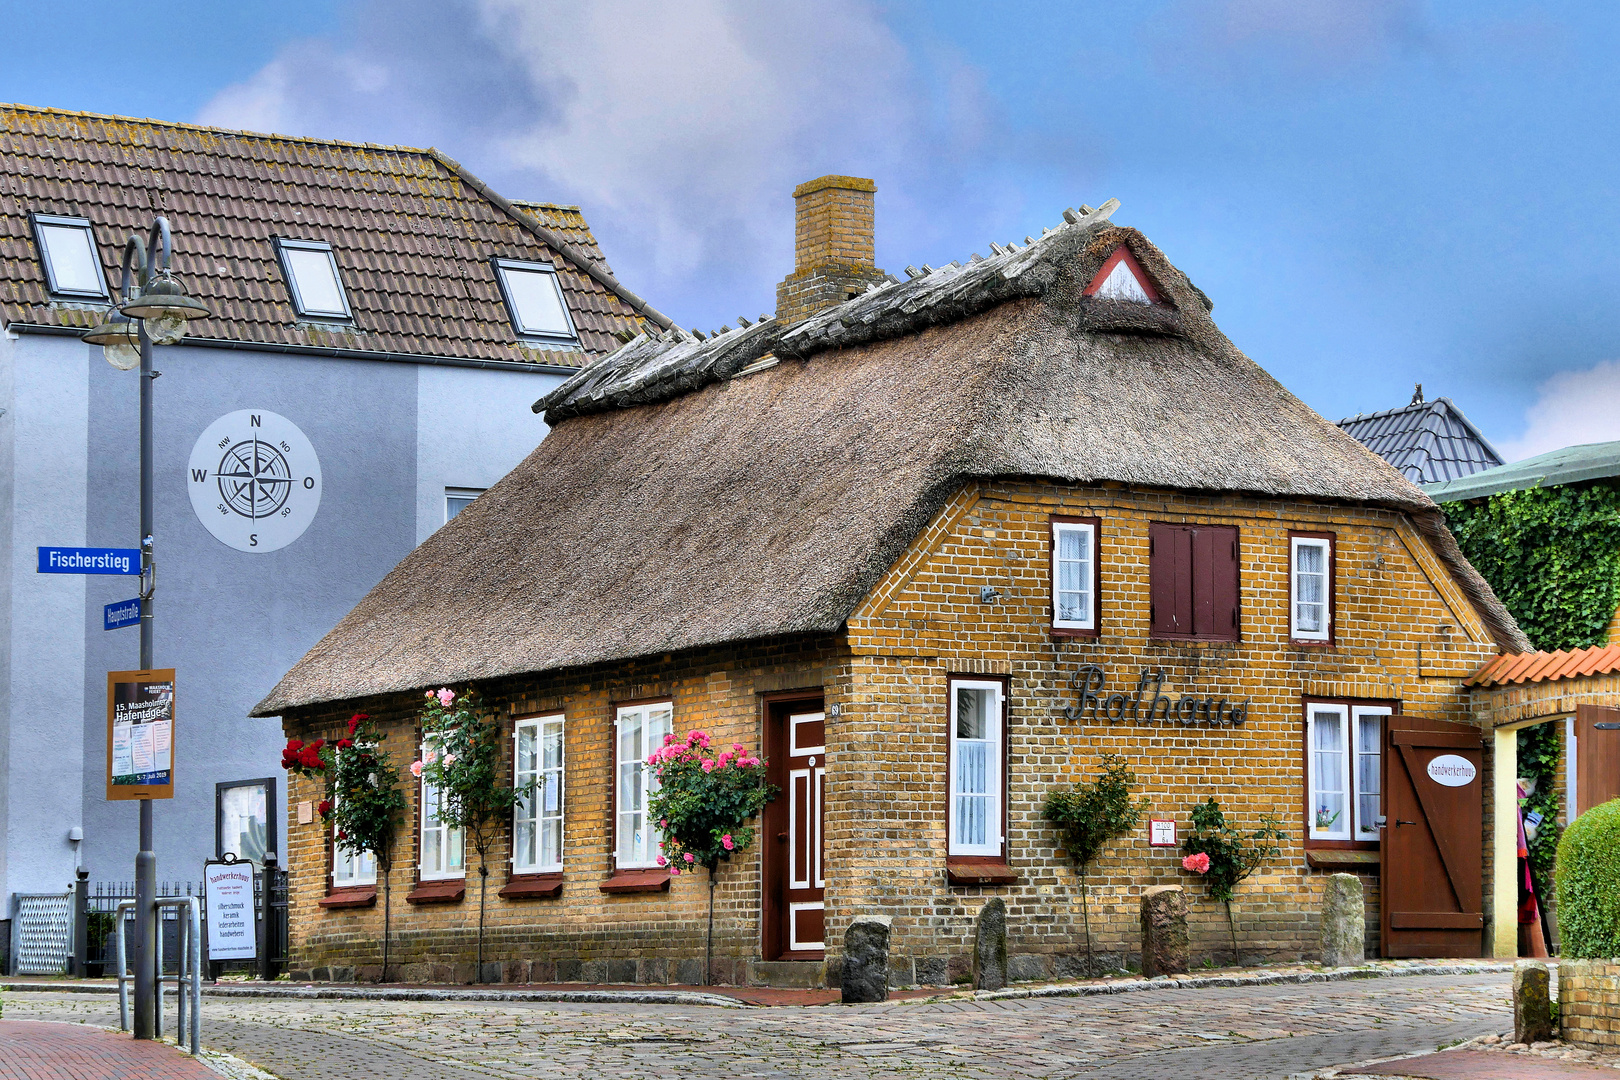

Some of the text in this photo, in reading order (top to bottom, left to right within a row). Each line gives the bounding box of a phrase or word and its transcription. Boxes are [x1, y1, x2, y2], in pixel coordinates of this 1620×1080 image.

[250, 414, 261, 428] N
[217, 436, 231, 450] NW
[279, 440, 291, 453] NO
[191, 468, 208, 483] W
[303, 476, 315, 490] O
[216, 503, 229, 516] SW
[280, 507, 292, 519] SO
[249, 533, 258, 547] S
[49, 551, 130, 573] Fischerstieg
[107, 603, 139, 626] Hauptstraße
[1065, 665, 1251, 725] Rathaus
[116, 699, 168, 712] 15. Maasholmer
[116, 708, 161, 722] Hafentage
[210, 872, 249, 884] handwerkerhuus
[217, 902, 244, 910] silberschmuck
[218, 921, 245, 929] lederarbeiten
[219, 930, 245, 938] handweberei
